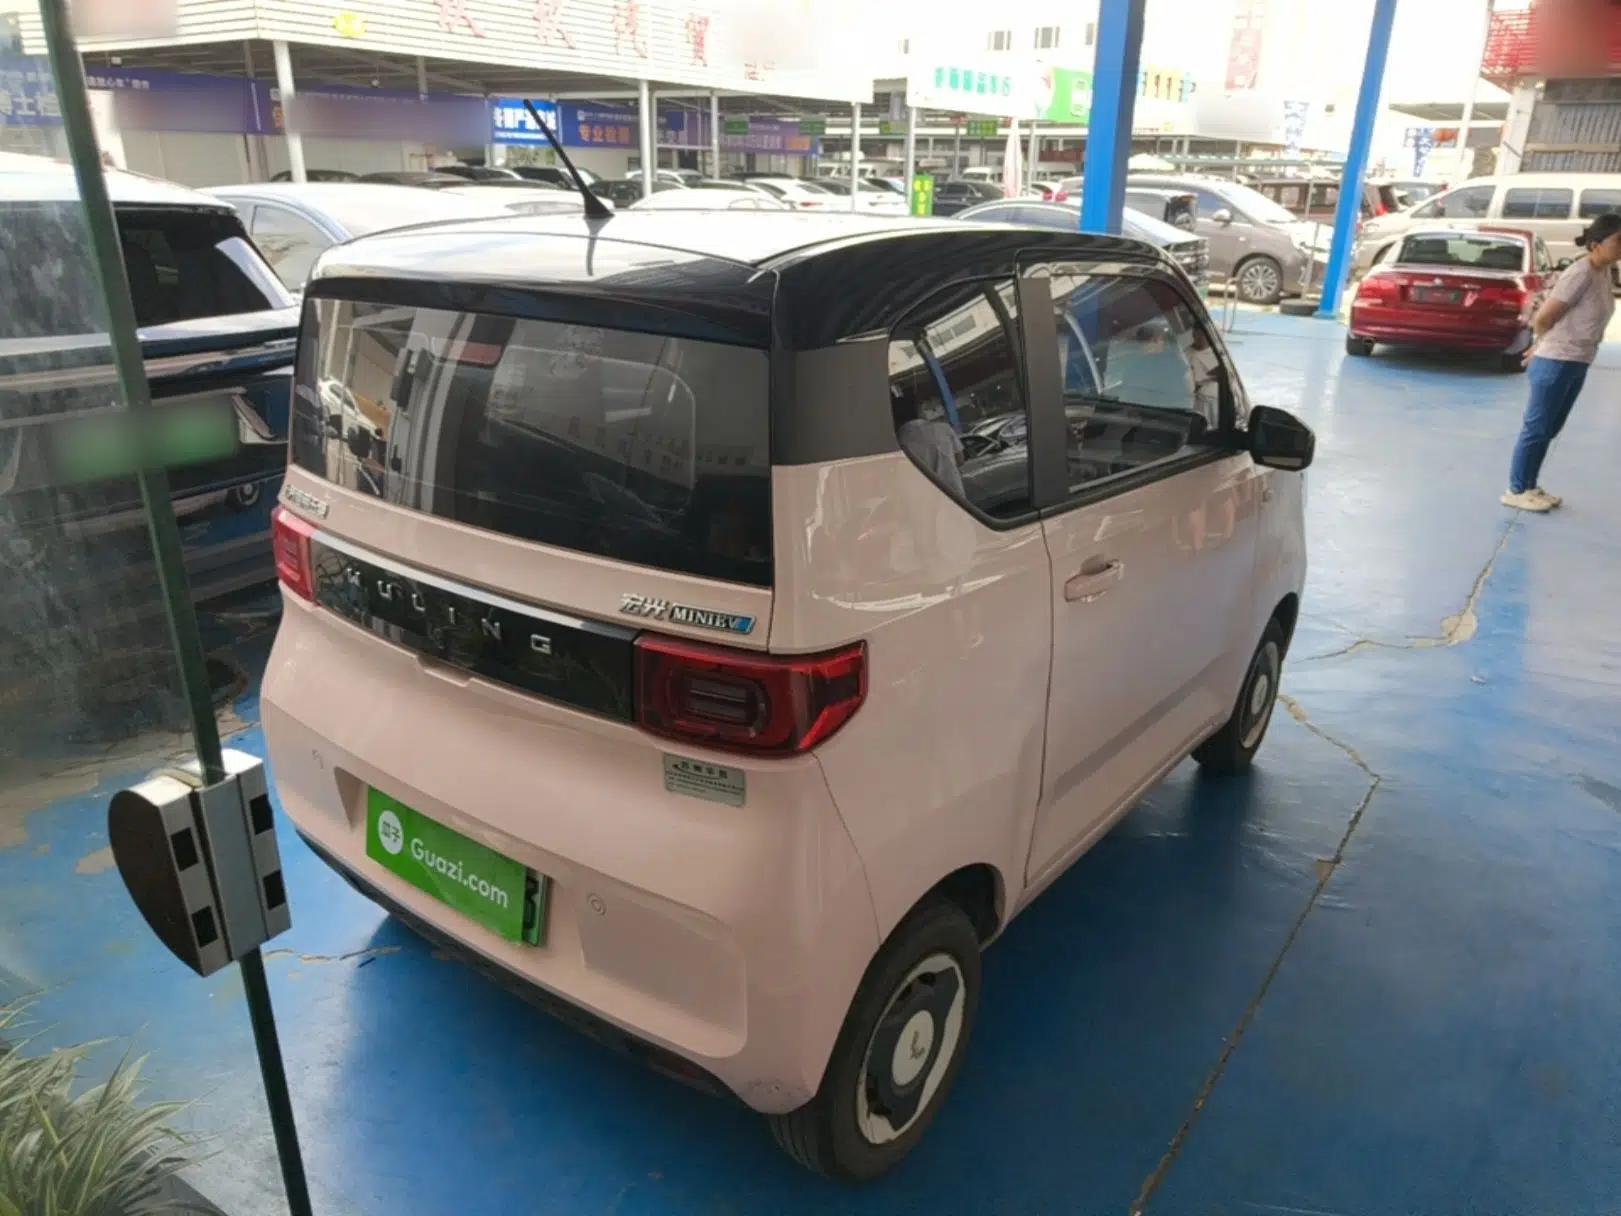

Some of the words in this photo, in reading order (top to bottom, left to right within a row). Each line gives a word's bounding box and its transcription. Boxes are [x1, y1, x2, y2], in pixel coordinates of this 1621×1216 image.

[346, 566, 552, 655] WULING
[621, 592, 668, 620] 宏光
[672, 605, 741, 630] MINIEV
[411, 837, 509, 909] Guazi.com
